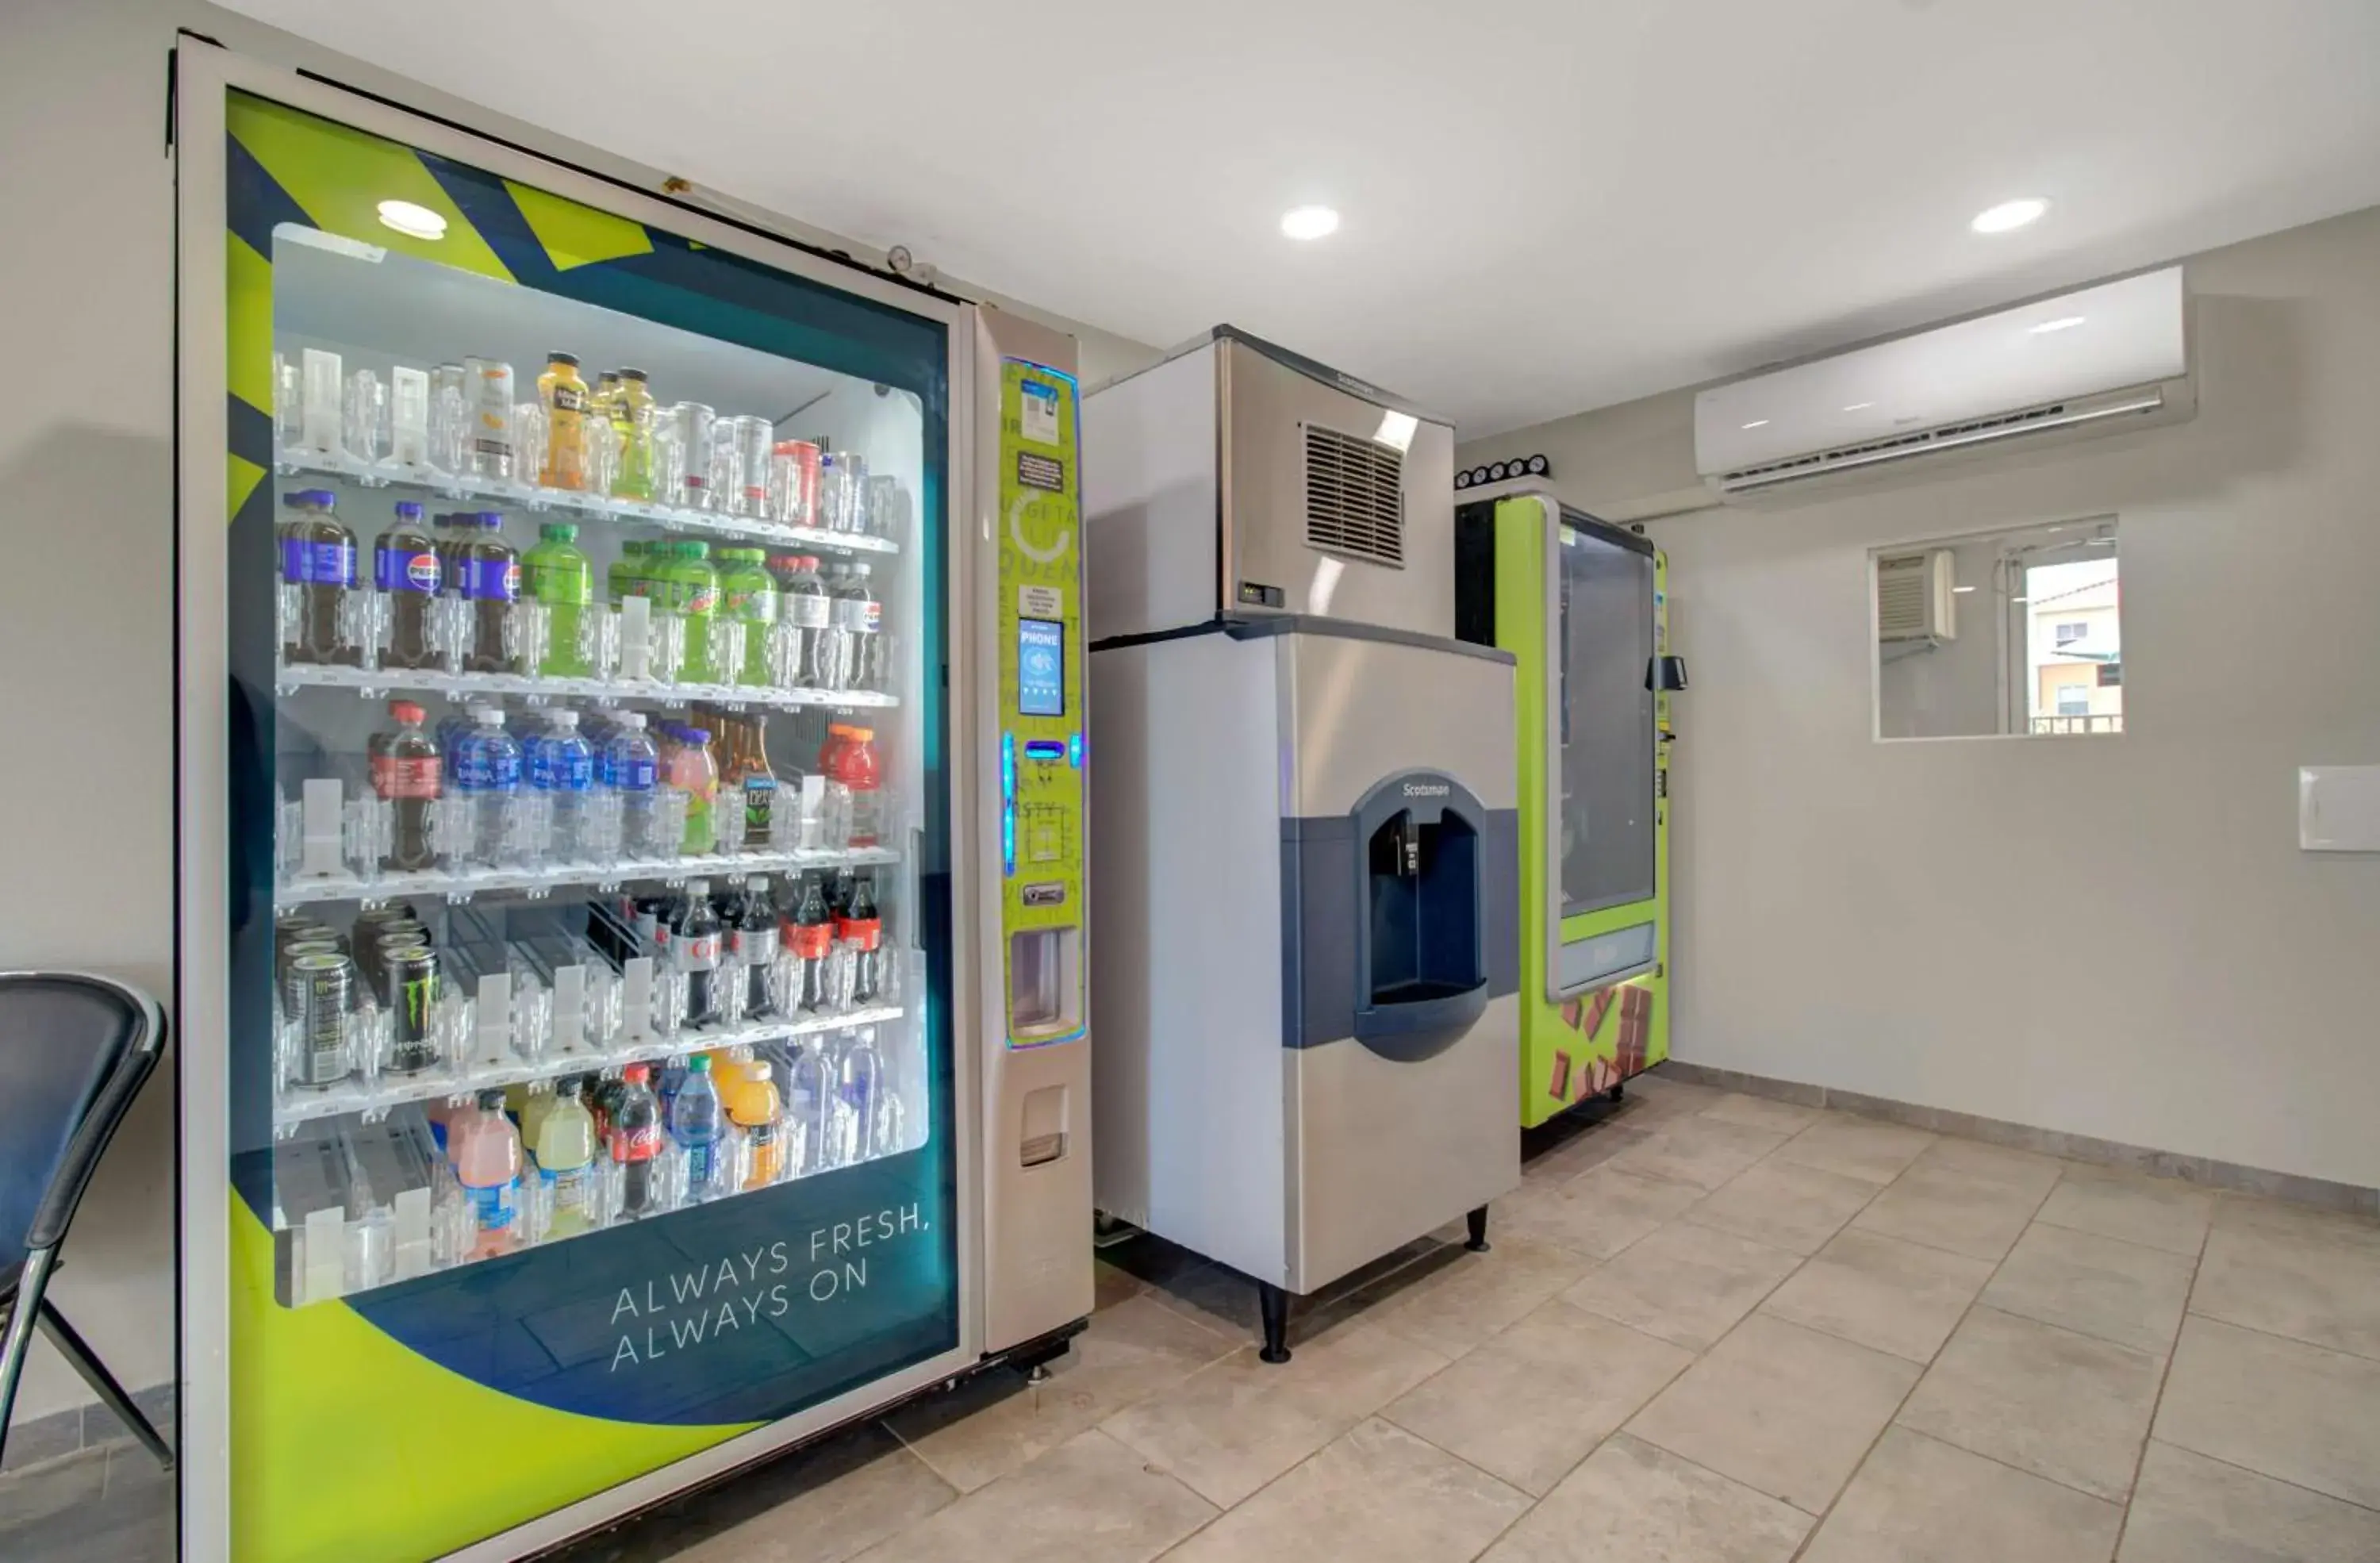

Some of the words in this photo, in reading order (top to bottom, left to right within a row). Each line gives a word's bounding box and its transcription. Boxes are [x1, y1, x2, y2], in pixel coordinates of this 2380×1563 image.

[1020, 632, 1058, 646] PHONE
[1403, 783, 1449, 797] Scotsman
[611, 1241, 789, 1324] ALWAYS
[811, 1202, 929, 1262] FRESH,
[611, 1285, 789, 1372] ALWAYS
[810, 1258, 866, 1301] ON
